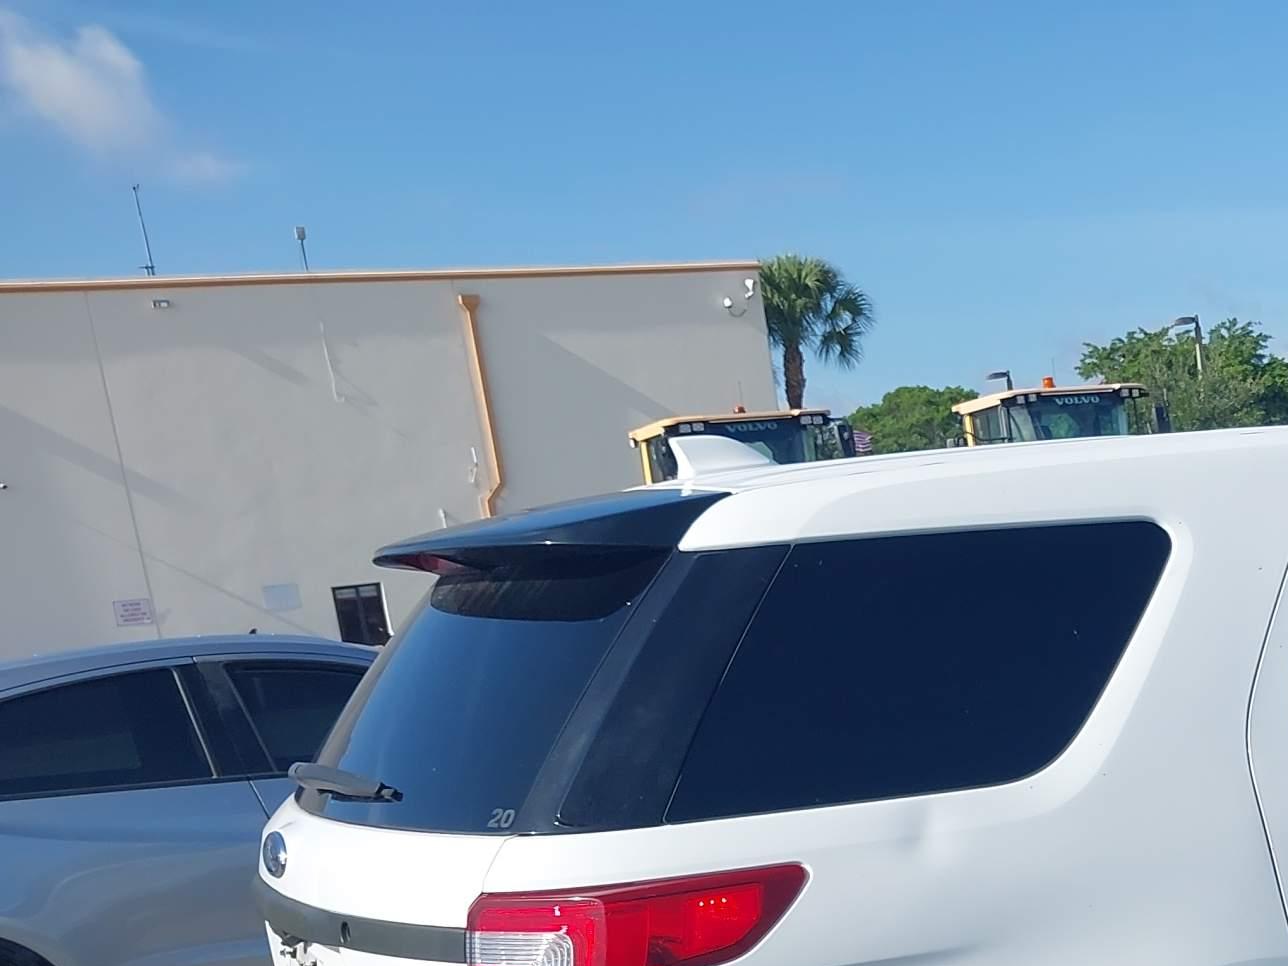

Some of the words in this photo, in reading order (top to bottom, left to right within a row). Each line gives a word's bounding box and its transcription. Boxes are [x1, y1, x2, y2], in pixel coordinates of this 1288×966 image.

[1055, 395, 1100, 406] VOLVO
[725, 421, 778, 432] VOLVO
[487, 808, 516, 828] 20
